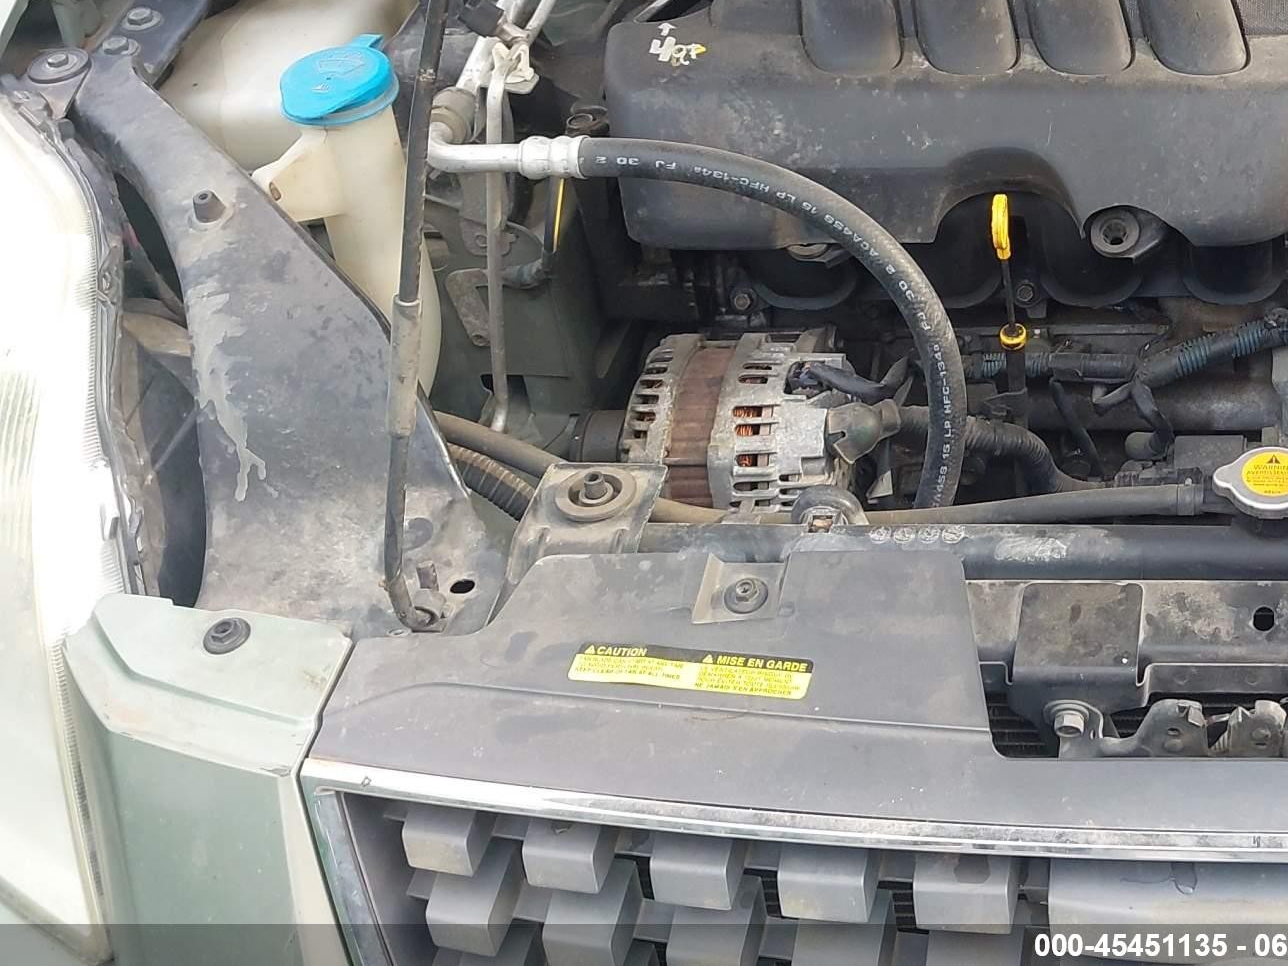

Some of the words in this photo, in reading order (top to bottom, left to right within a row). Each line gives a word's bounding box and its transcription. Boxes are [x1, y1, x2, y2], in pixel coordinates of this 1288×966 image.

[655, 160, 678, 172] FJ
[693, 166, 769, 194] HFC-134a
[775, 191, 797, 205] LP
[596, 645, 648, 657] CAUTION
[716, 655, 746, 666] MISE
[747, 658, 764, 668] EN
[766, 660, 808, 672] GARDE
